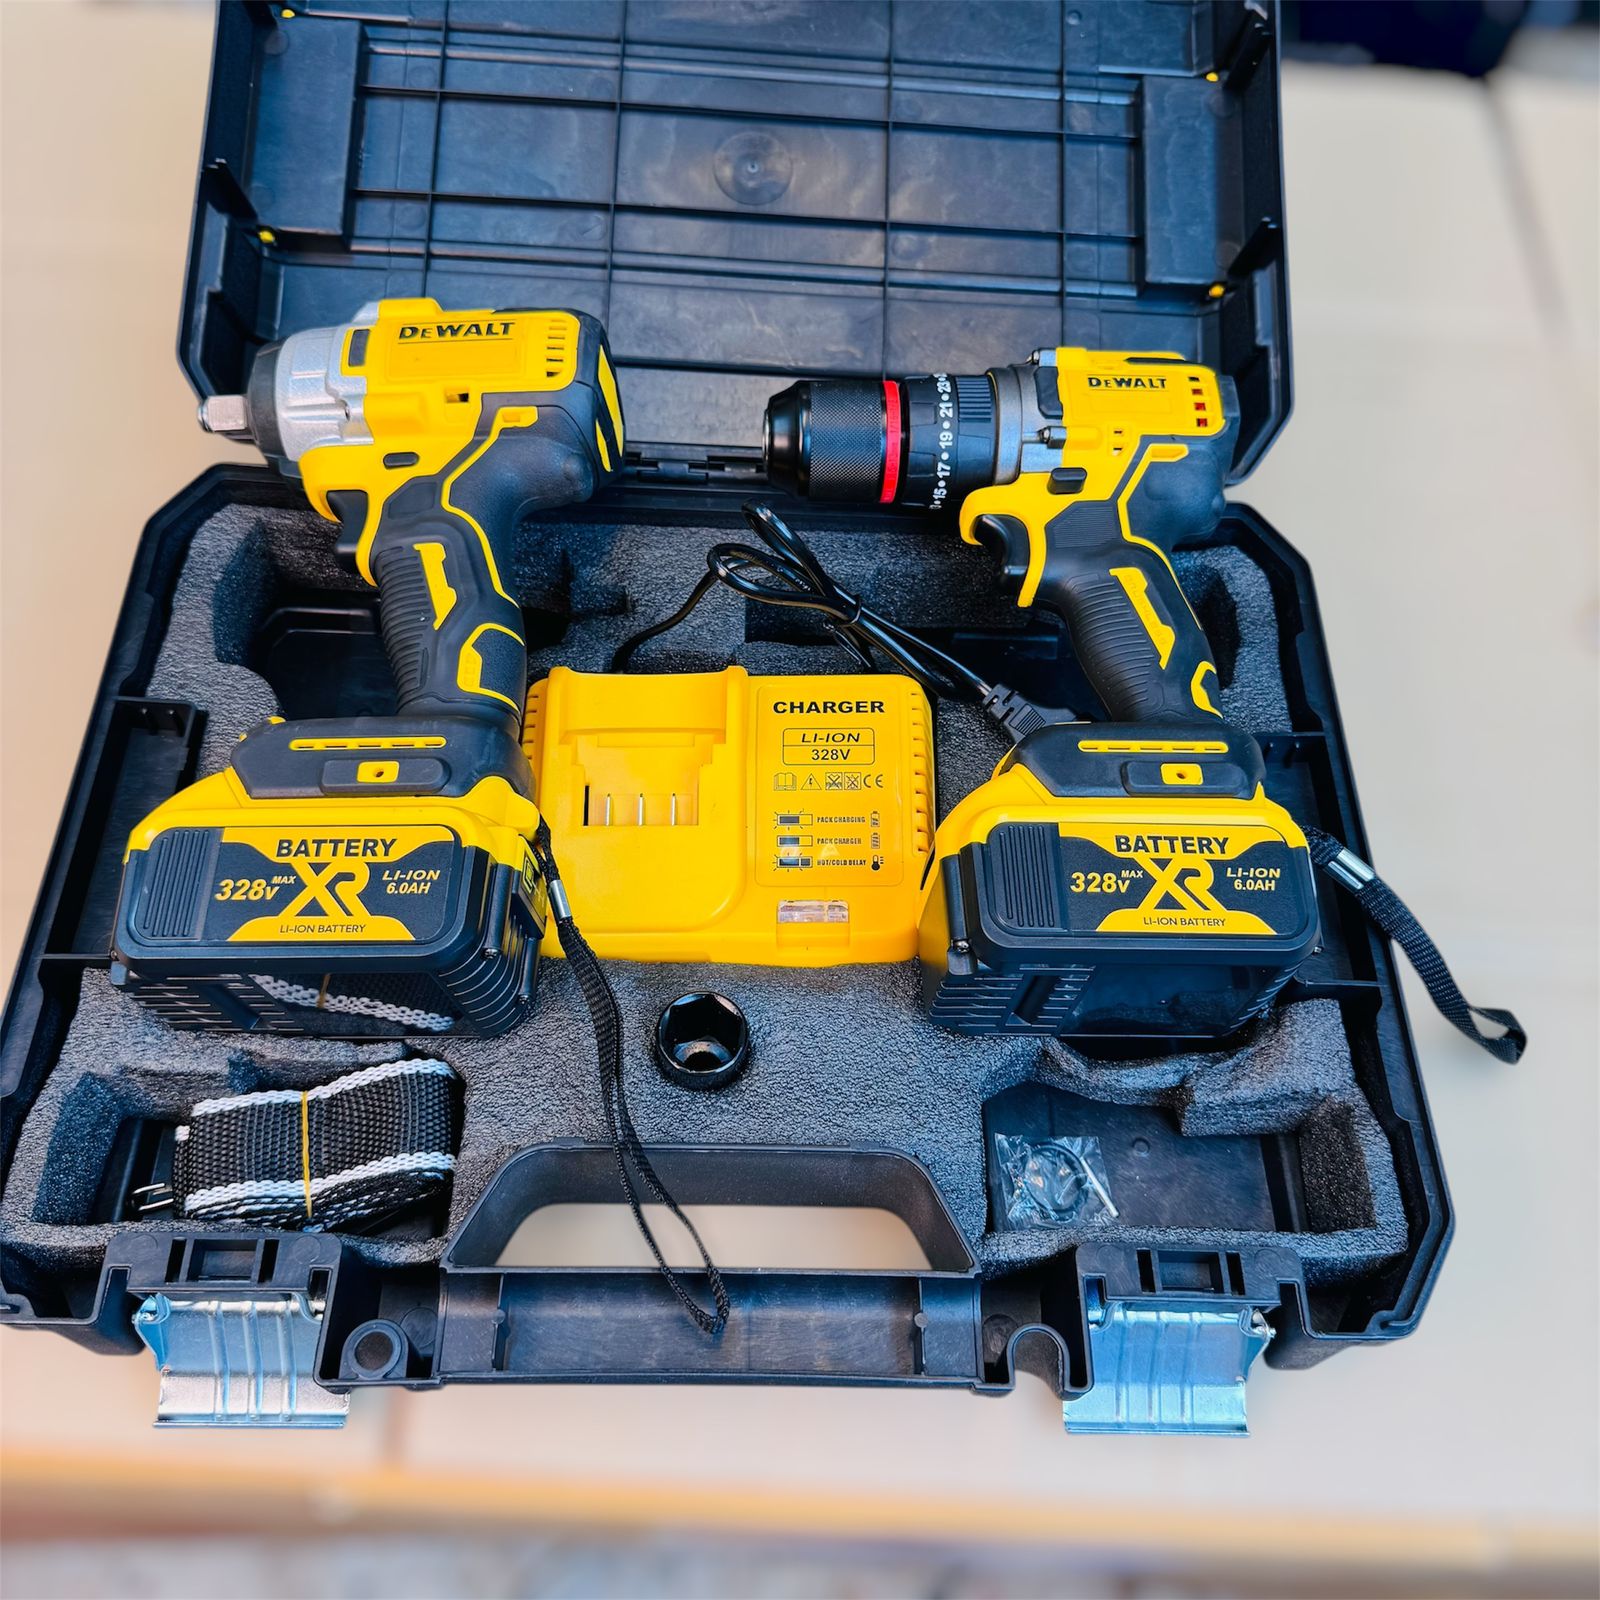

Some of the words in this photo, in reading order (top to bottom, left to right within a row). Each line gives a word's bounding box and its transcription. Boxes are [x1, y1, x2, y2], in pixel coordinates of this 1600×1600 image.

[939, 402, 953, 418] 21
[939, 431, 953, 449] 19
[937, 461, 951, 478] 17
[773, 700, 885, 714] CHARGER
[801, 732, 861, 743] LI-ION
[811, 749, 850, 761] 328V
[276, 838, 397, 858] BATTERY
[1114, 835, 1229, 854] BATTERY
[382, 869, 441, 881] LI-ION
[1121, 870, 1143, 878] MAX
[1226, 867, 1281, 878] LI-ION
[272, 876, 296, 885] MAX
[1137, 858, 1228, 911] XR
[1234, 879, 1276, 891] 6.0AH
[278, 861, 371, 917] XR
[386, 882, 431, 894] 6.0AH
[1143, 917, 1178, 926] LI-ION
[1180, 917, 1227, 927] BATTERY
[279, 924, 315, 934] LI-ION
[317, 924, 367, 933] BATTERY
